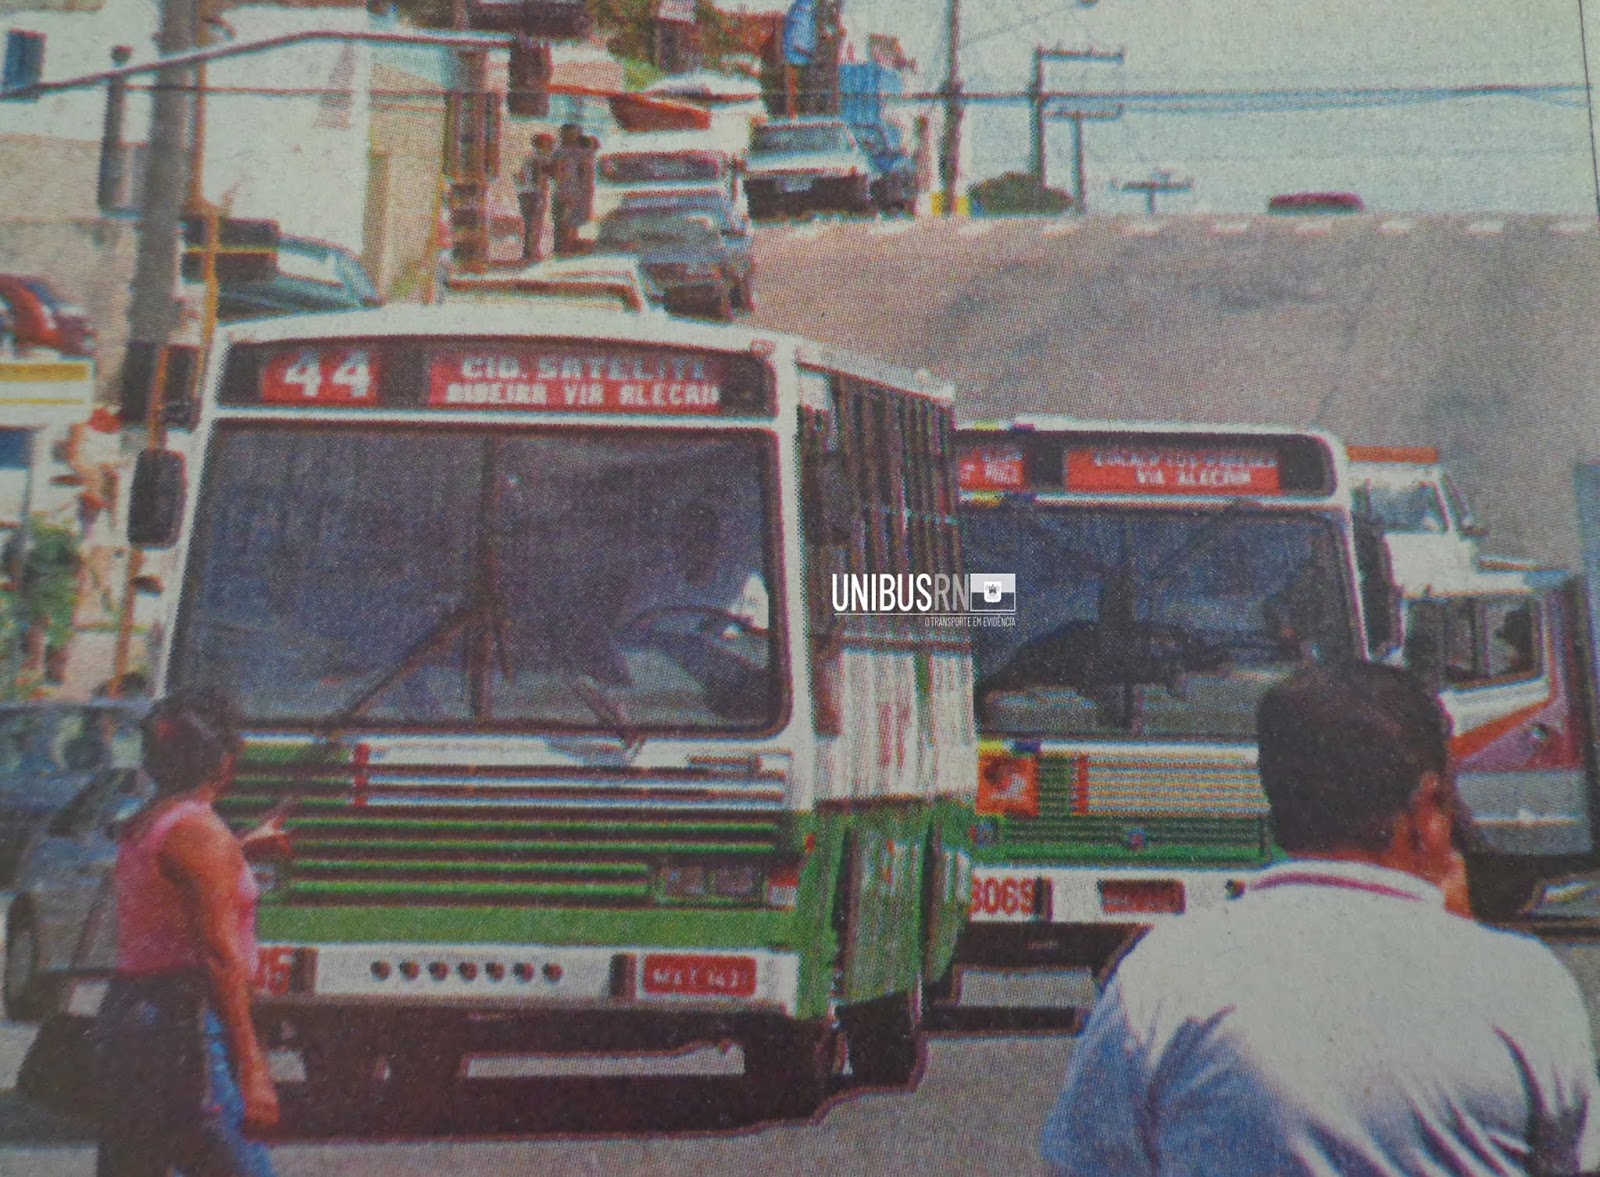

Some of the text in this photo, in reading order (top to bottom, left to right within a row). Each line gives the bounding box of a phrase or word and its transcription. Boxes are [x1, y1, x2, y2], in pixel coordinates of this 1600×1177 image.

[284, 350, 370, 398] 44
[563, 383, 603, 405] VIA
[1137, 468, 1165, 485] VIA
